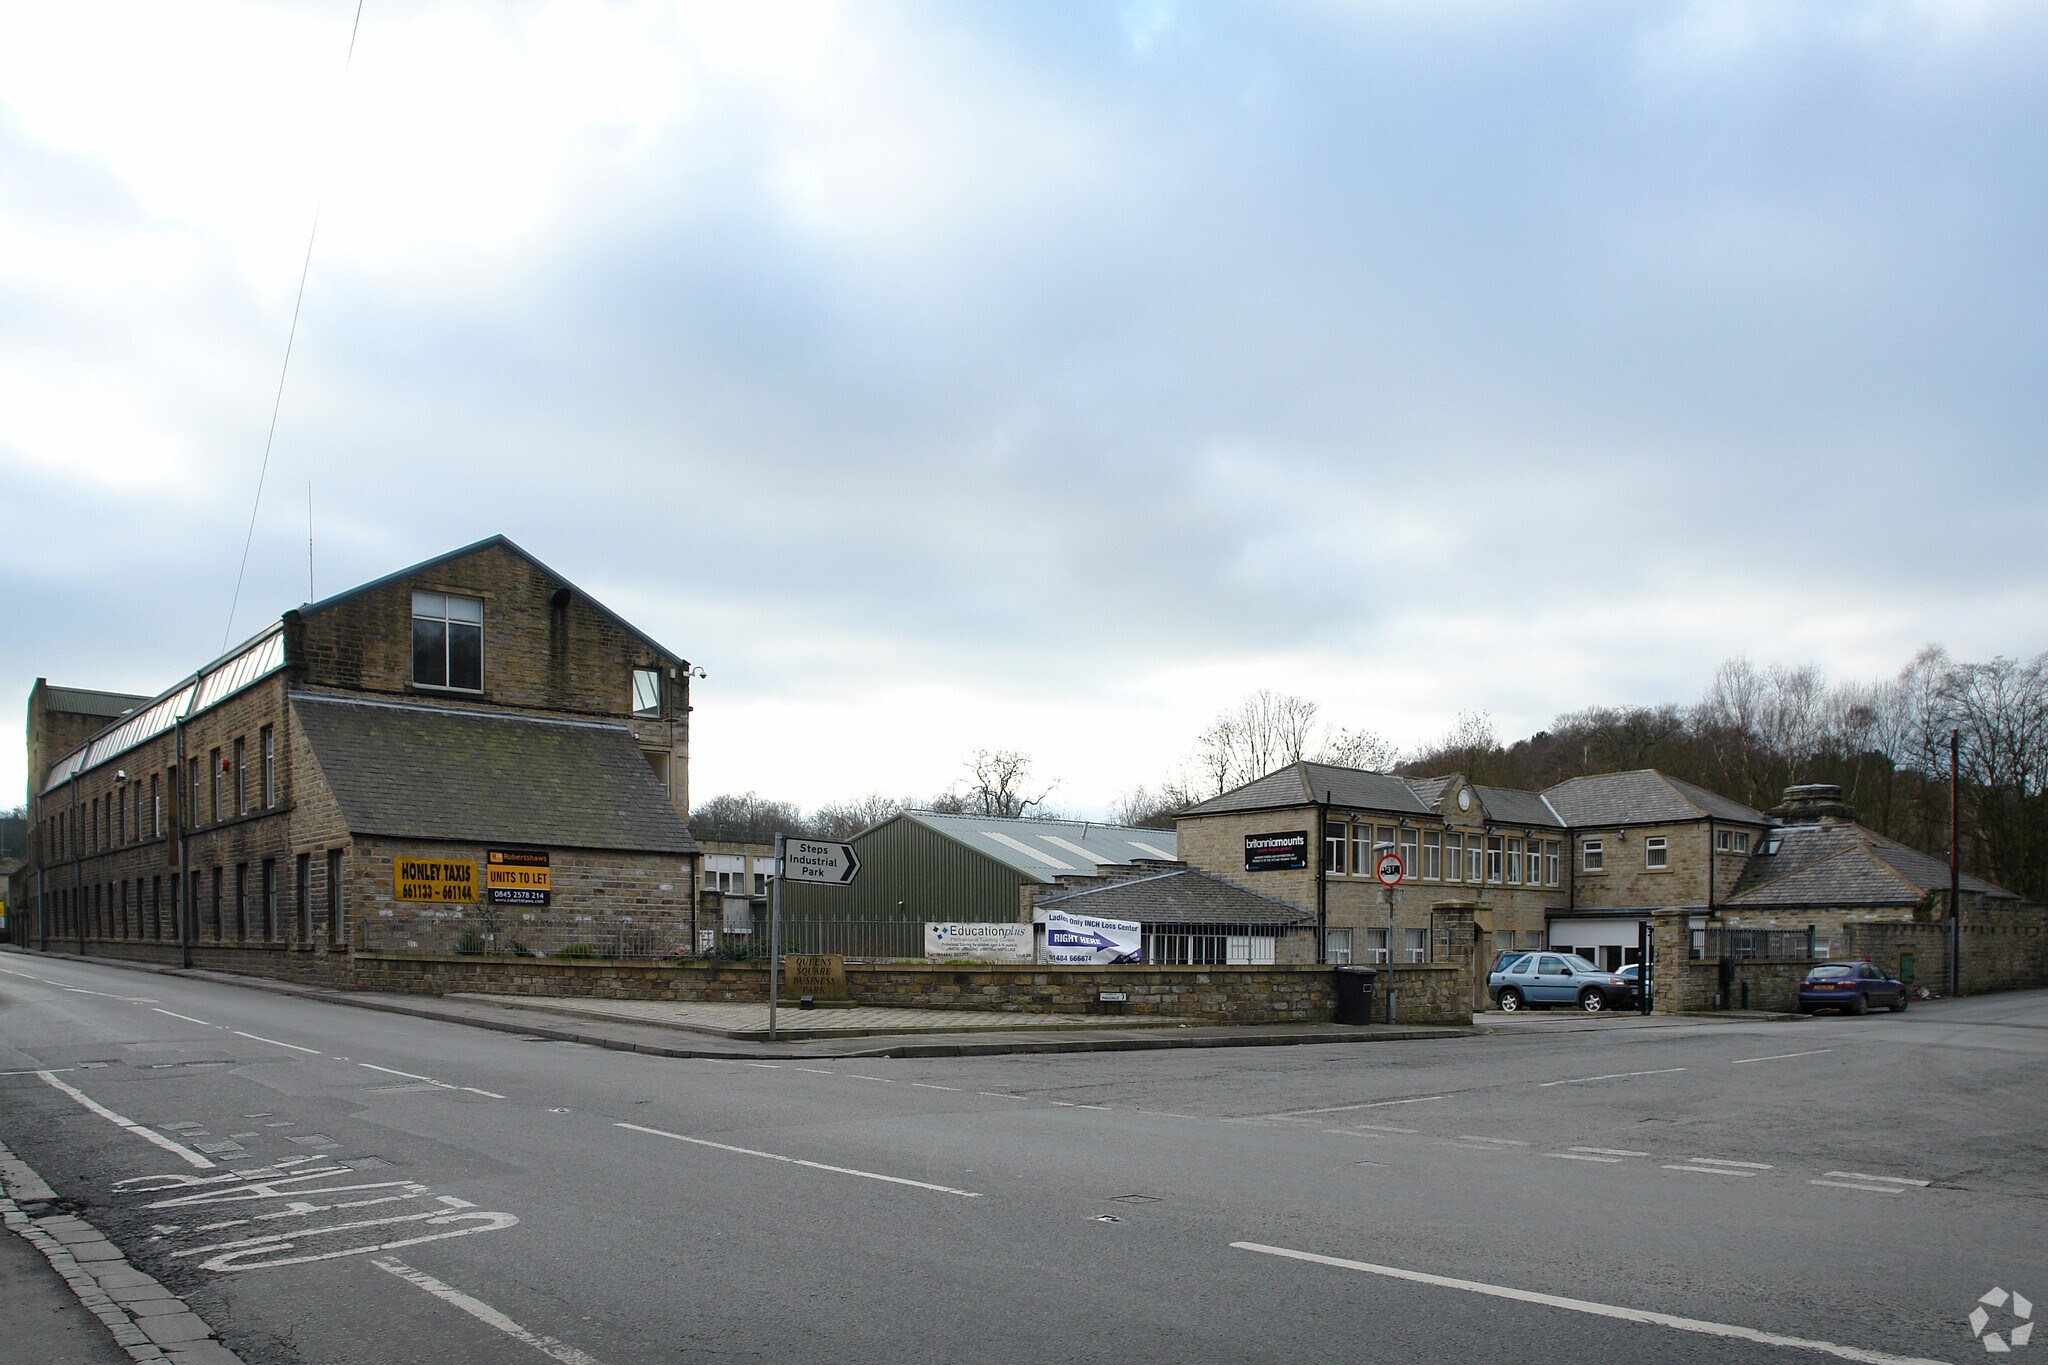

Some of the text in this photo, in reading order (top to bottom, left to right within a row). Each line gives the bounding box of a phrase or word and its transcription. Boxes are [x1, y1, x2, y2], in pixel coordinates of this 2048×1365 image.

[1246, 836, 1304, 848] britanniamounts
[800, 844, 828, 854] Steps
[504, 853, 547, 862] Robertshaws
[790, 854, 837, 867] Industrial
[402, 863, 471, 882] HONLEY TAXIS
[802, 867, 824, 876] Park
[490, 871, 547, 884] UNITS TO LET
[403, 884, 432, 899] 661133
[443, 885, 472, 900] 661144
[1070, 918, 1083, 927] Only
[1085, 920, 1100, 928] INCH
[1117, 924, 1138, 932] Center
[1054, 934, 1102, 945] RIGHT HERE
[796, 958, 832, 966] QUEENS
[797, 967, 831, 976] SQUARE
[793, 976, 835, 984] BUSINESS
[802, 986, 825, 994] PARK
